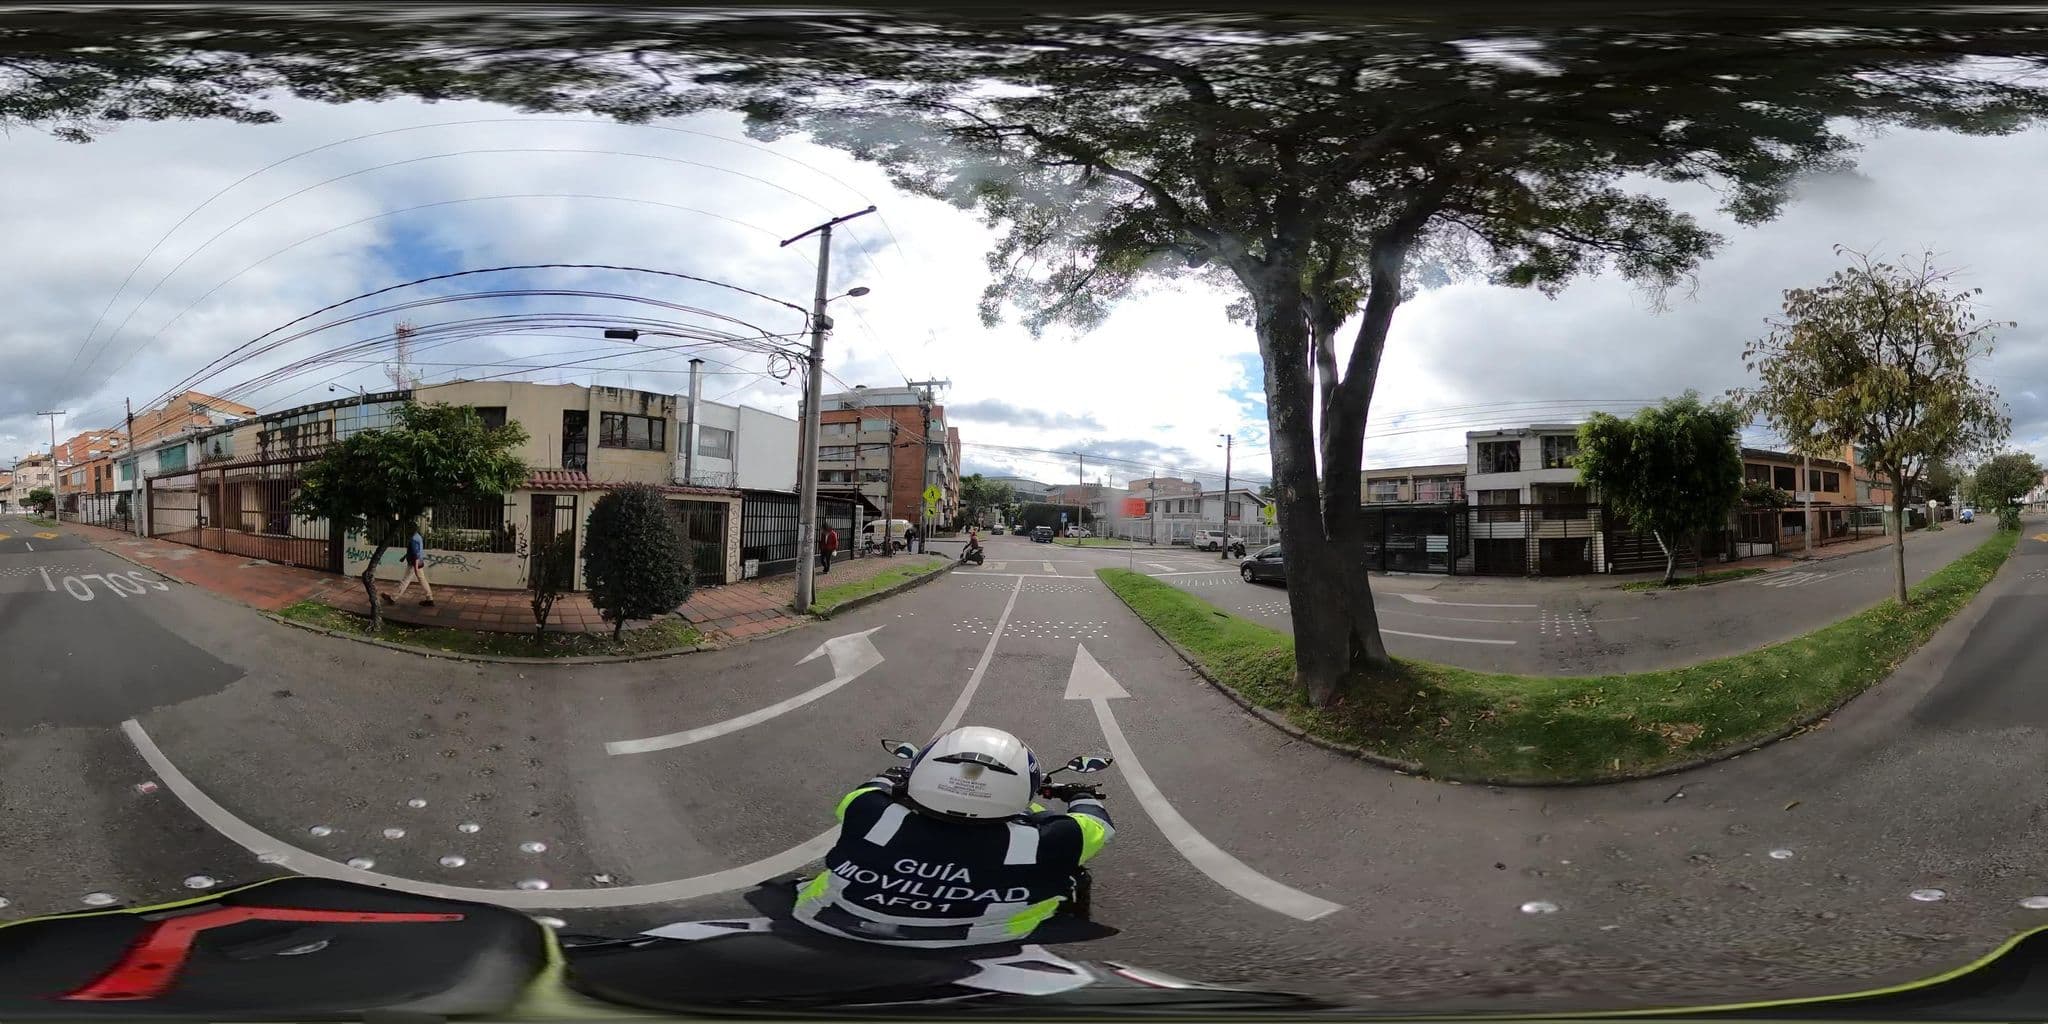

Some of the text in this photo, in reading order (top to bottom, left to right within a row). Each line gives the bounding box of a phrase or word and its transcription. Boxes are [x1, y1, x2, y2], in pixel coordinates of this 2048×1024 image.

[63, 571, 169, 601] SOLO
[833, 860, 1030, 902] MOVILIDAD
[893, 858, 971, 883] GUÍA
[864, 893, 951, 913] AF01
